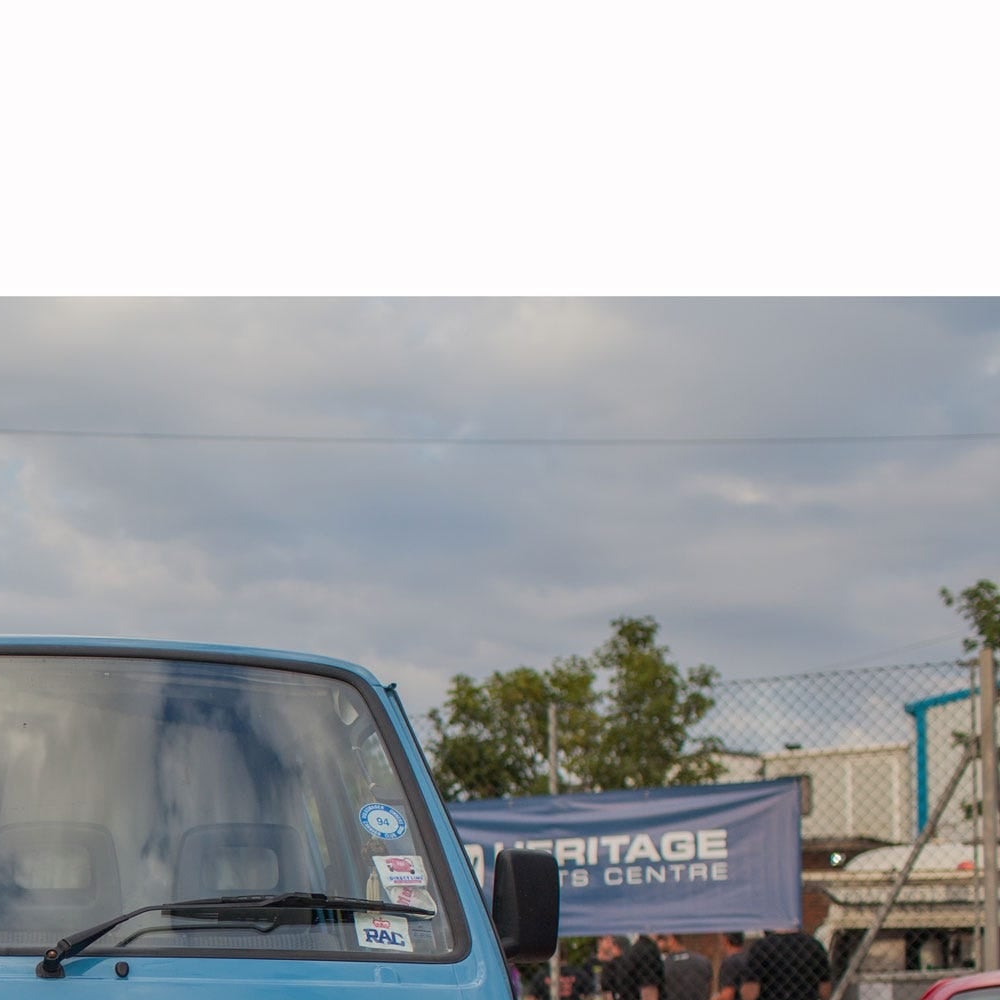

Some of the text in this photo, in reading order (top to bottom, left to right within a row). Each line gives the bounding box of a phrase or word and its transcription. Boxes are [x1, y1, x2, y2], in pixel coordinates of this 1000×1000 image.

[376, 817, 390, 826] 94
[604, 862, 728, 886] CENTRE
[364, 928, 405, 947] RAC
